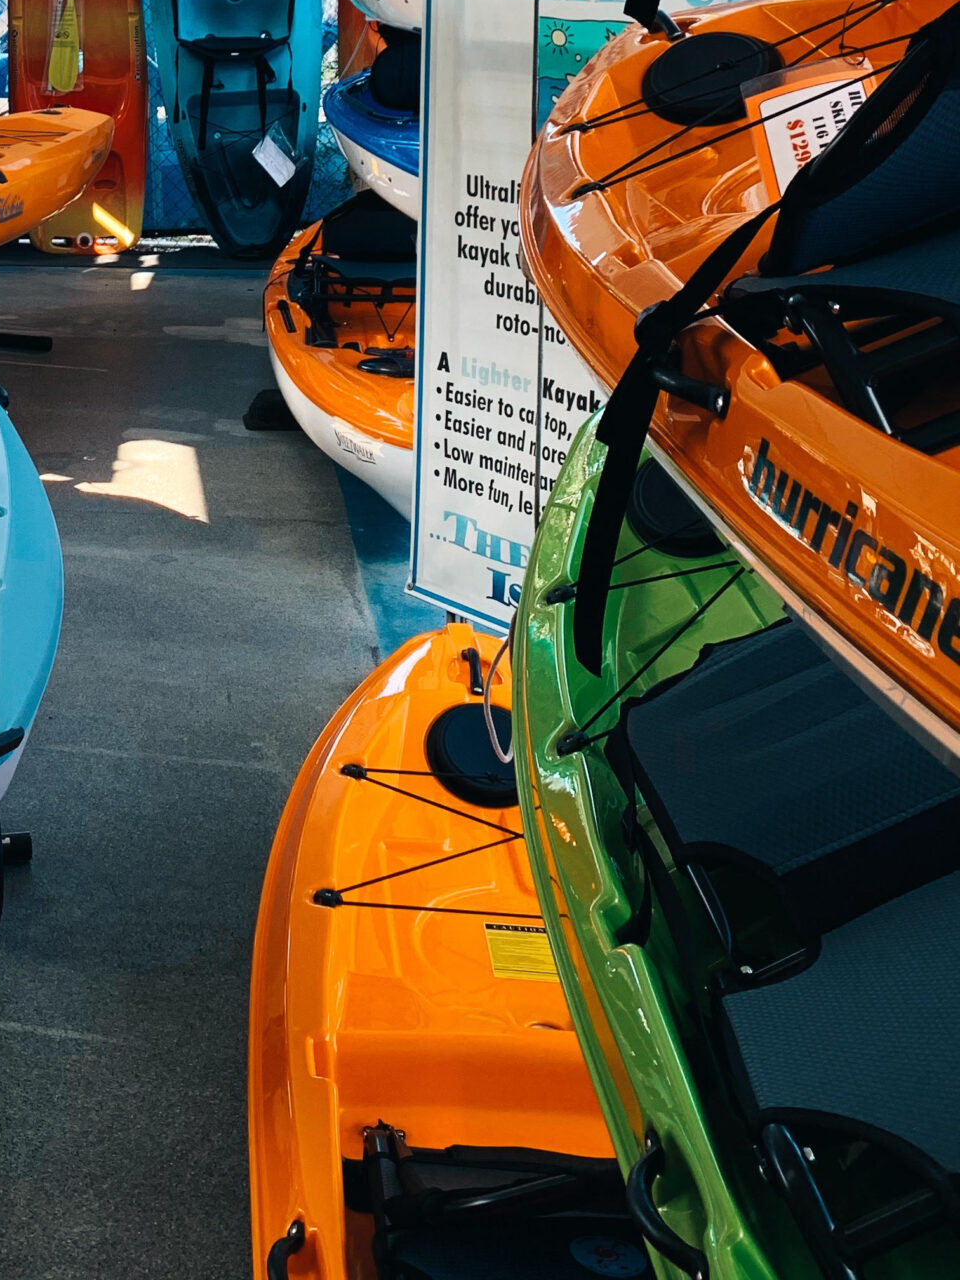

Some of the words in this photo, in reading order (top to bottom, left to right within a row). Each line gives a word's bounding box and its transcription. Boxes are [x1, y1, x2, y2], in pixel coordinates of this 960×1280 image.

[812, 116, 829, 139] 116
[454, 205, 496, 233] offer
[457, 234, 511, 268] kayak
[437, 351, 451, 373] A
[461, 356, 532, 393] Lighter
[444, 409, 492, 442] Easier
[497, 429, 526, 453] and
[445, 381, 494, 413] Easier
[498, 397, 514, 419] to
[519, 406, 537, 426] ca
[544, 411, 573, 442] top,
[444, 437, 474, 466] Low
[443, 466, 484, 497] More
[488, 478, 514, 513] fun,
[748, 436, 960, 668] hurricane
